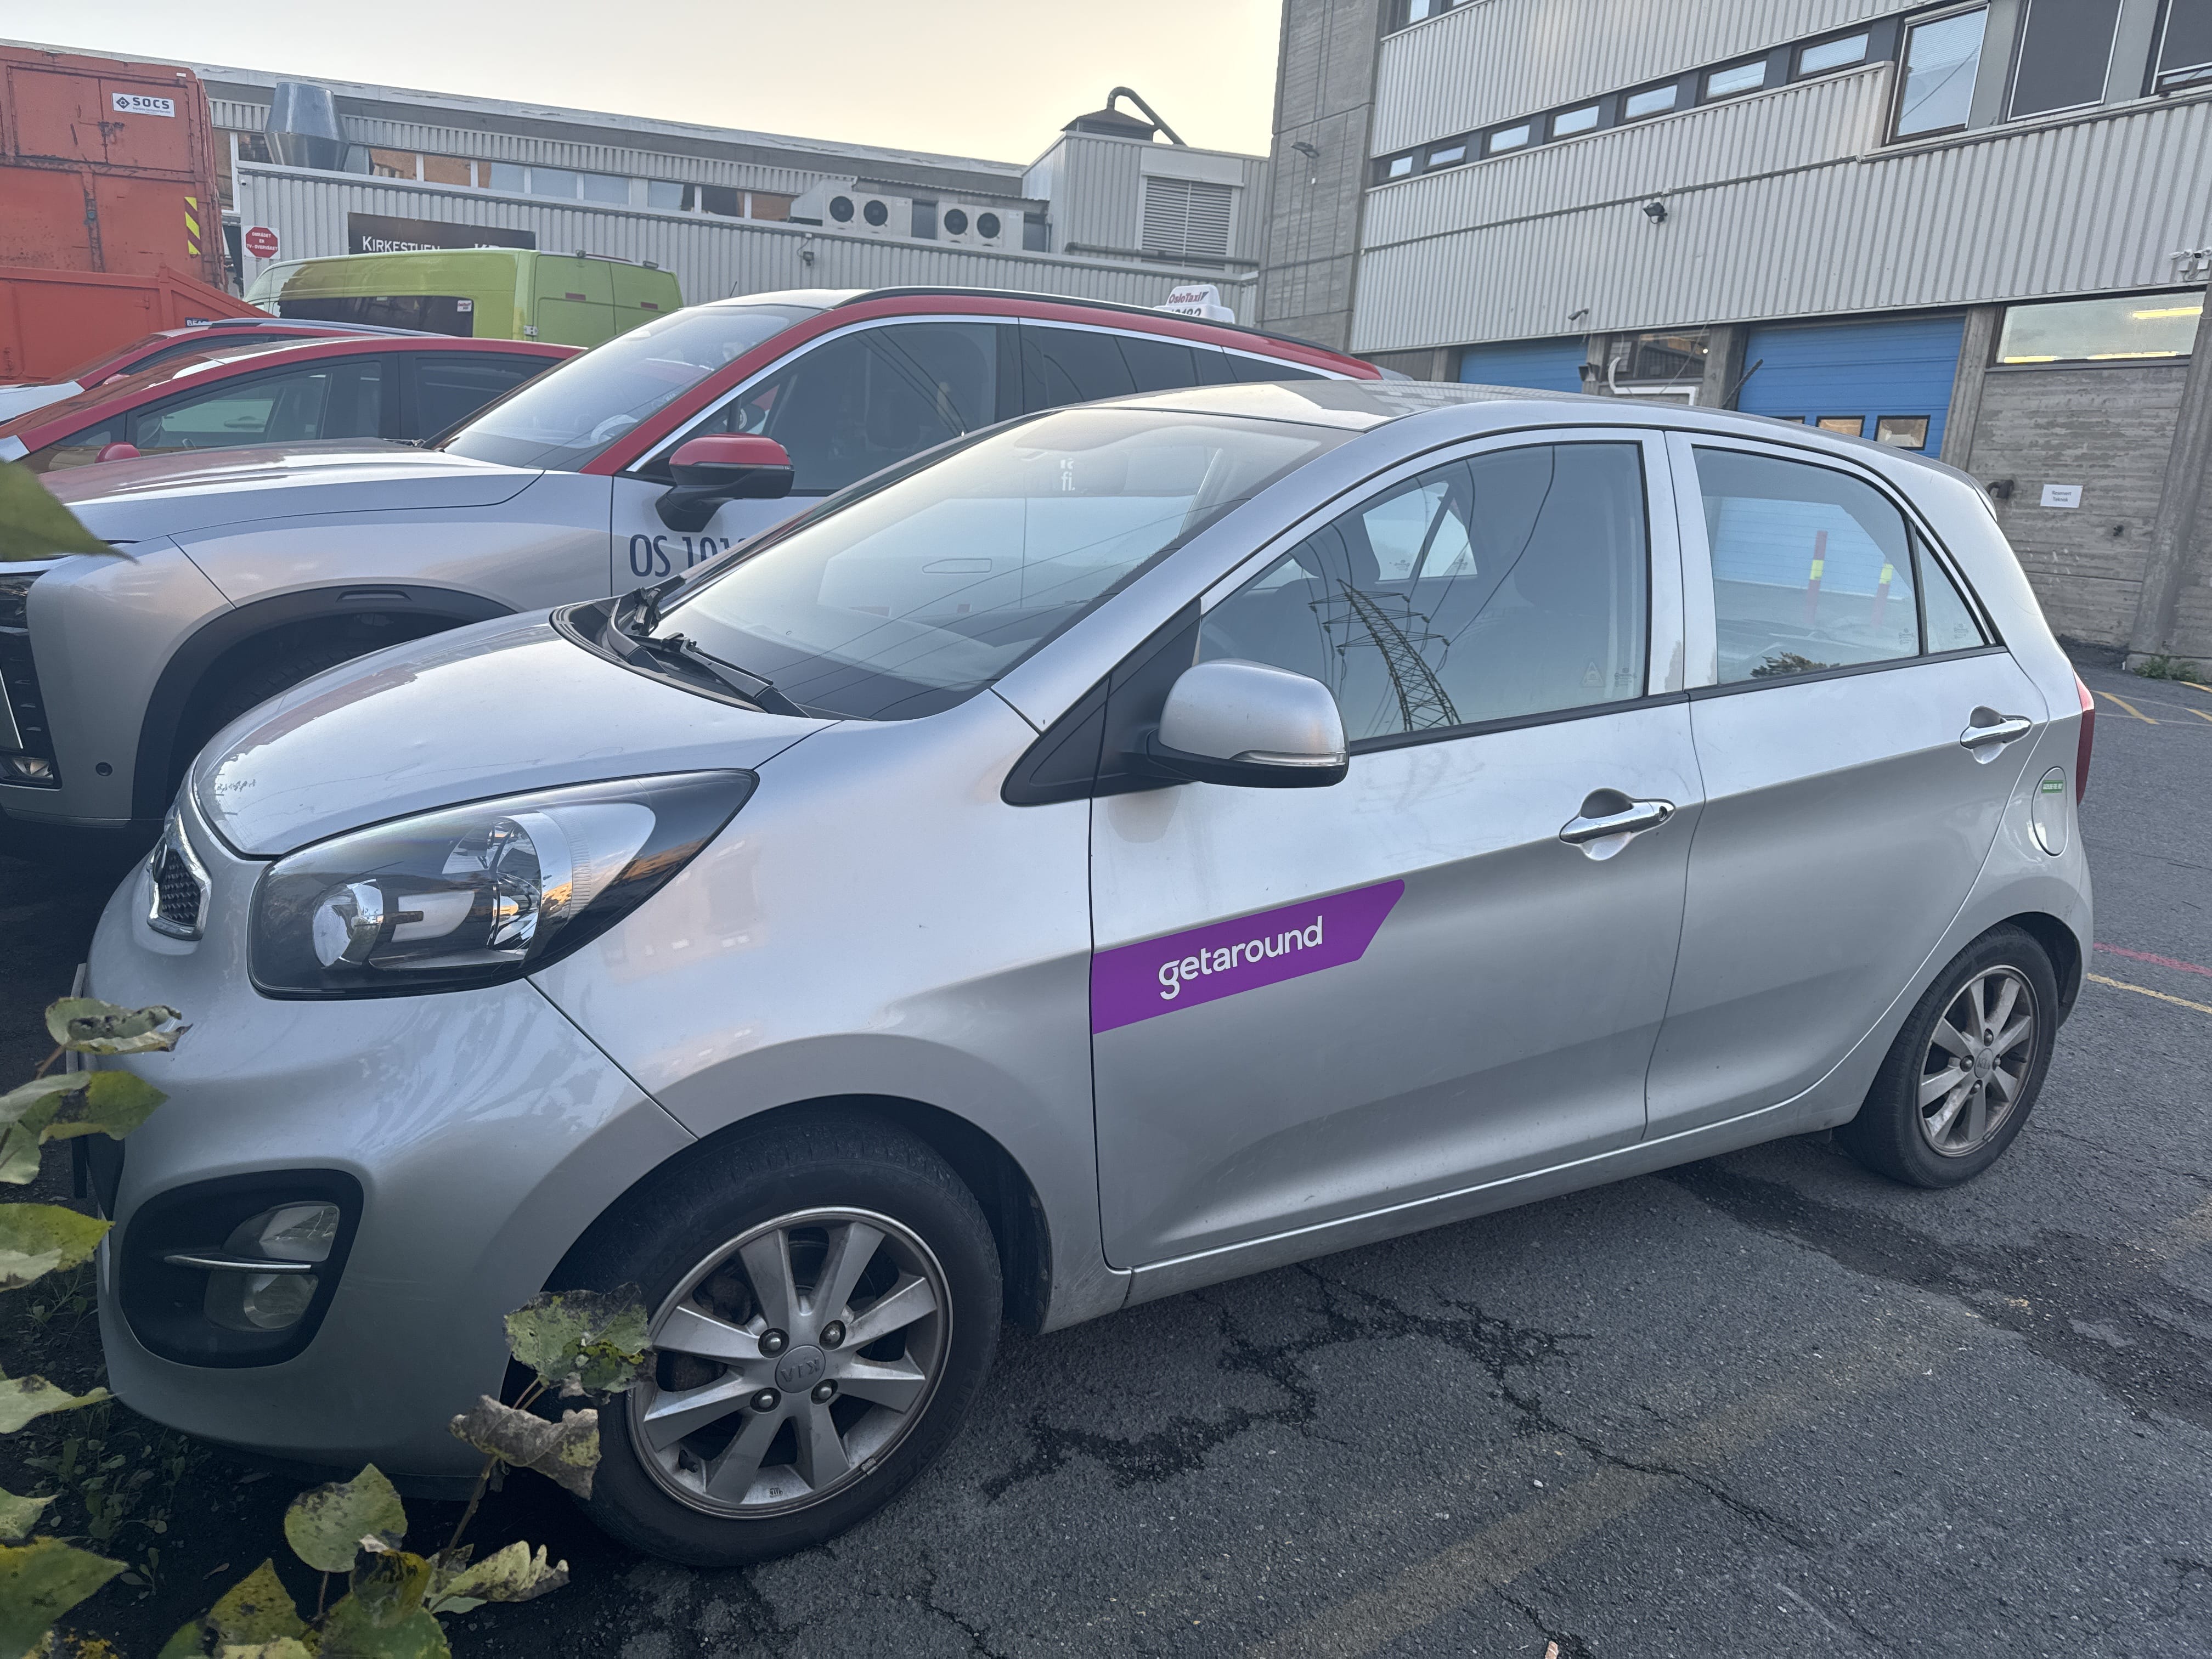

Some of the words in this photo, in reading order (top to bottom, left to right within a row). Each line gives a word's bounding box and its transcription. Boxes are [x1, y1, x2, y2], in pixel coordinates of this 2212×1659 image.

[132, 97, 170, 109] SOCS
[1168, 291, 1202, 304] OsloTaxi
[630, 534, 671, 577] OS
[1158, 915, 1323, 1001] getaround
[780, 1357, 820, 1383] KIA
